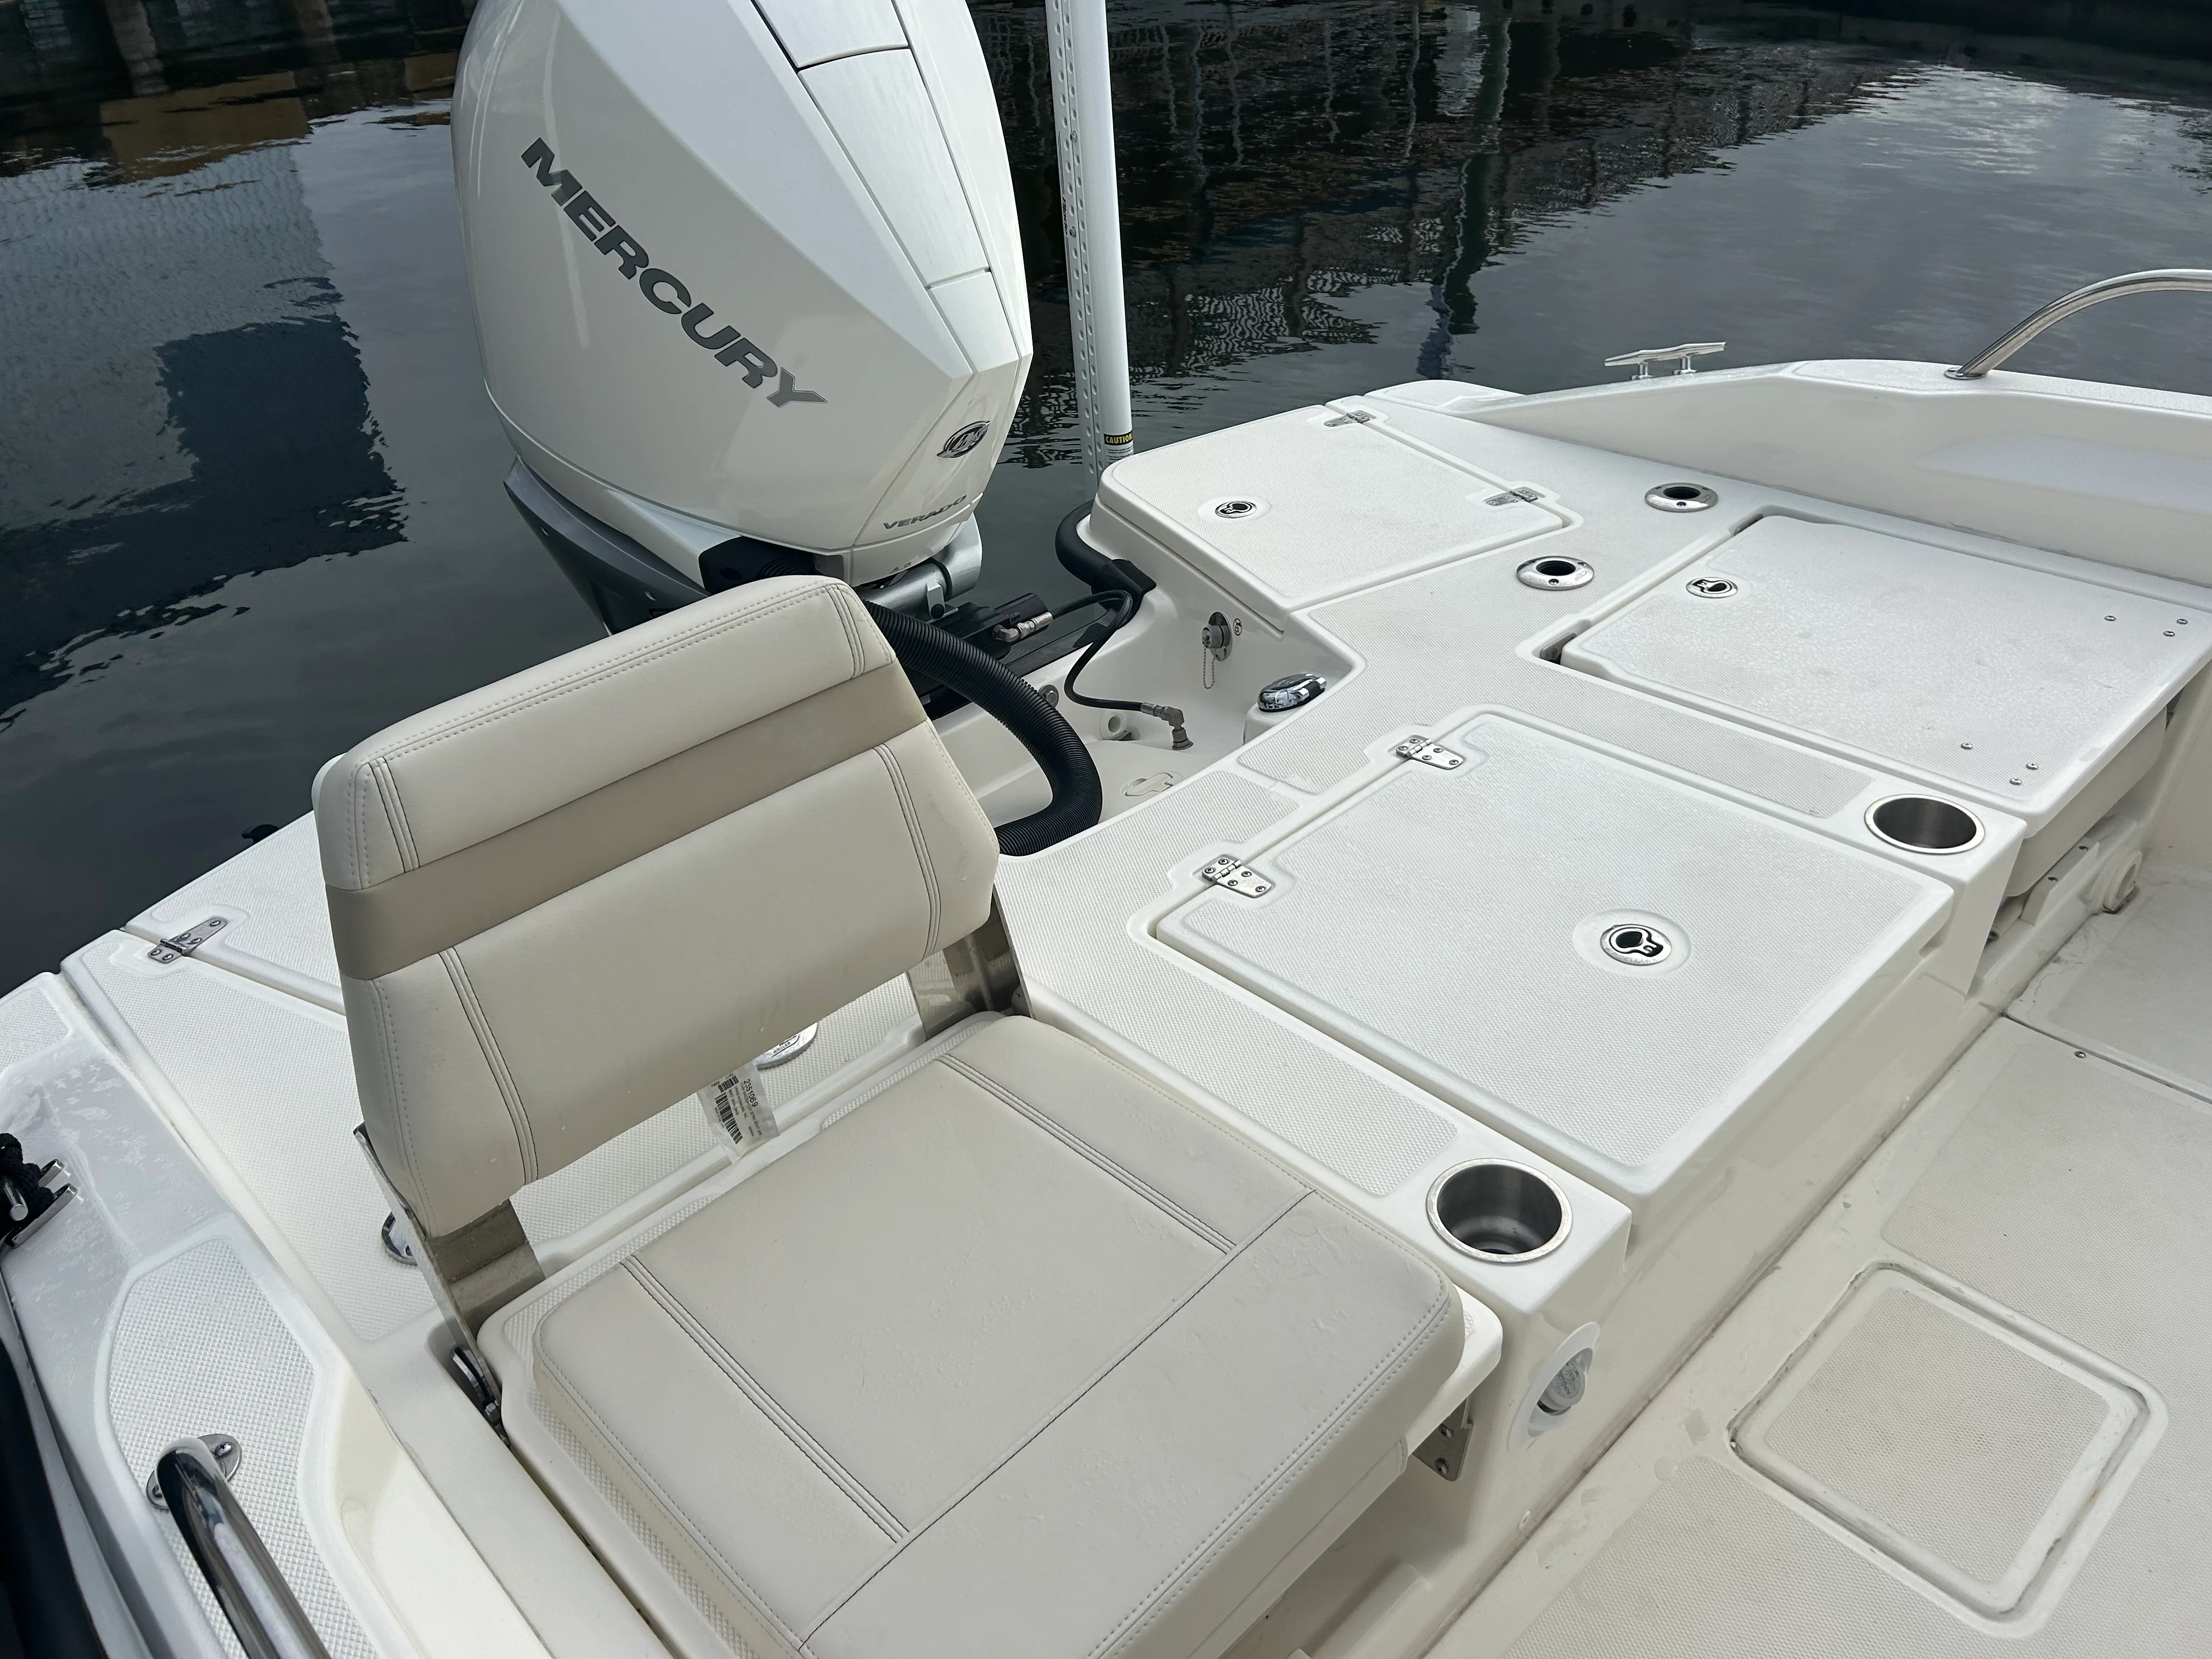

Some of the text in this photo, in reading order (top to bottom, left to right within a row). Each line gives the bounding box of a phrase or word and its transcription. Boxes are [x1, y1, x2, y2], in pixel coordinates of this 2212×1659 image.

[521, 138, 827, 408] MERCURY
[1105, 432, 1132, 444] CAUTION
[883, 495, 967, 529] VERADO
[743, 1079, 758, 1107] 2351069
